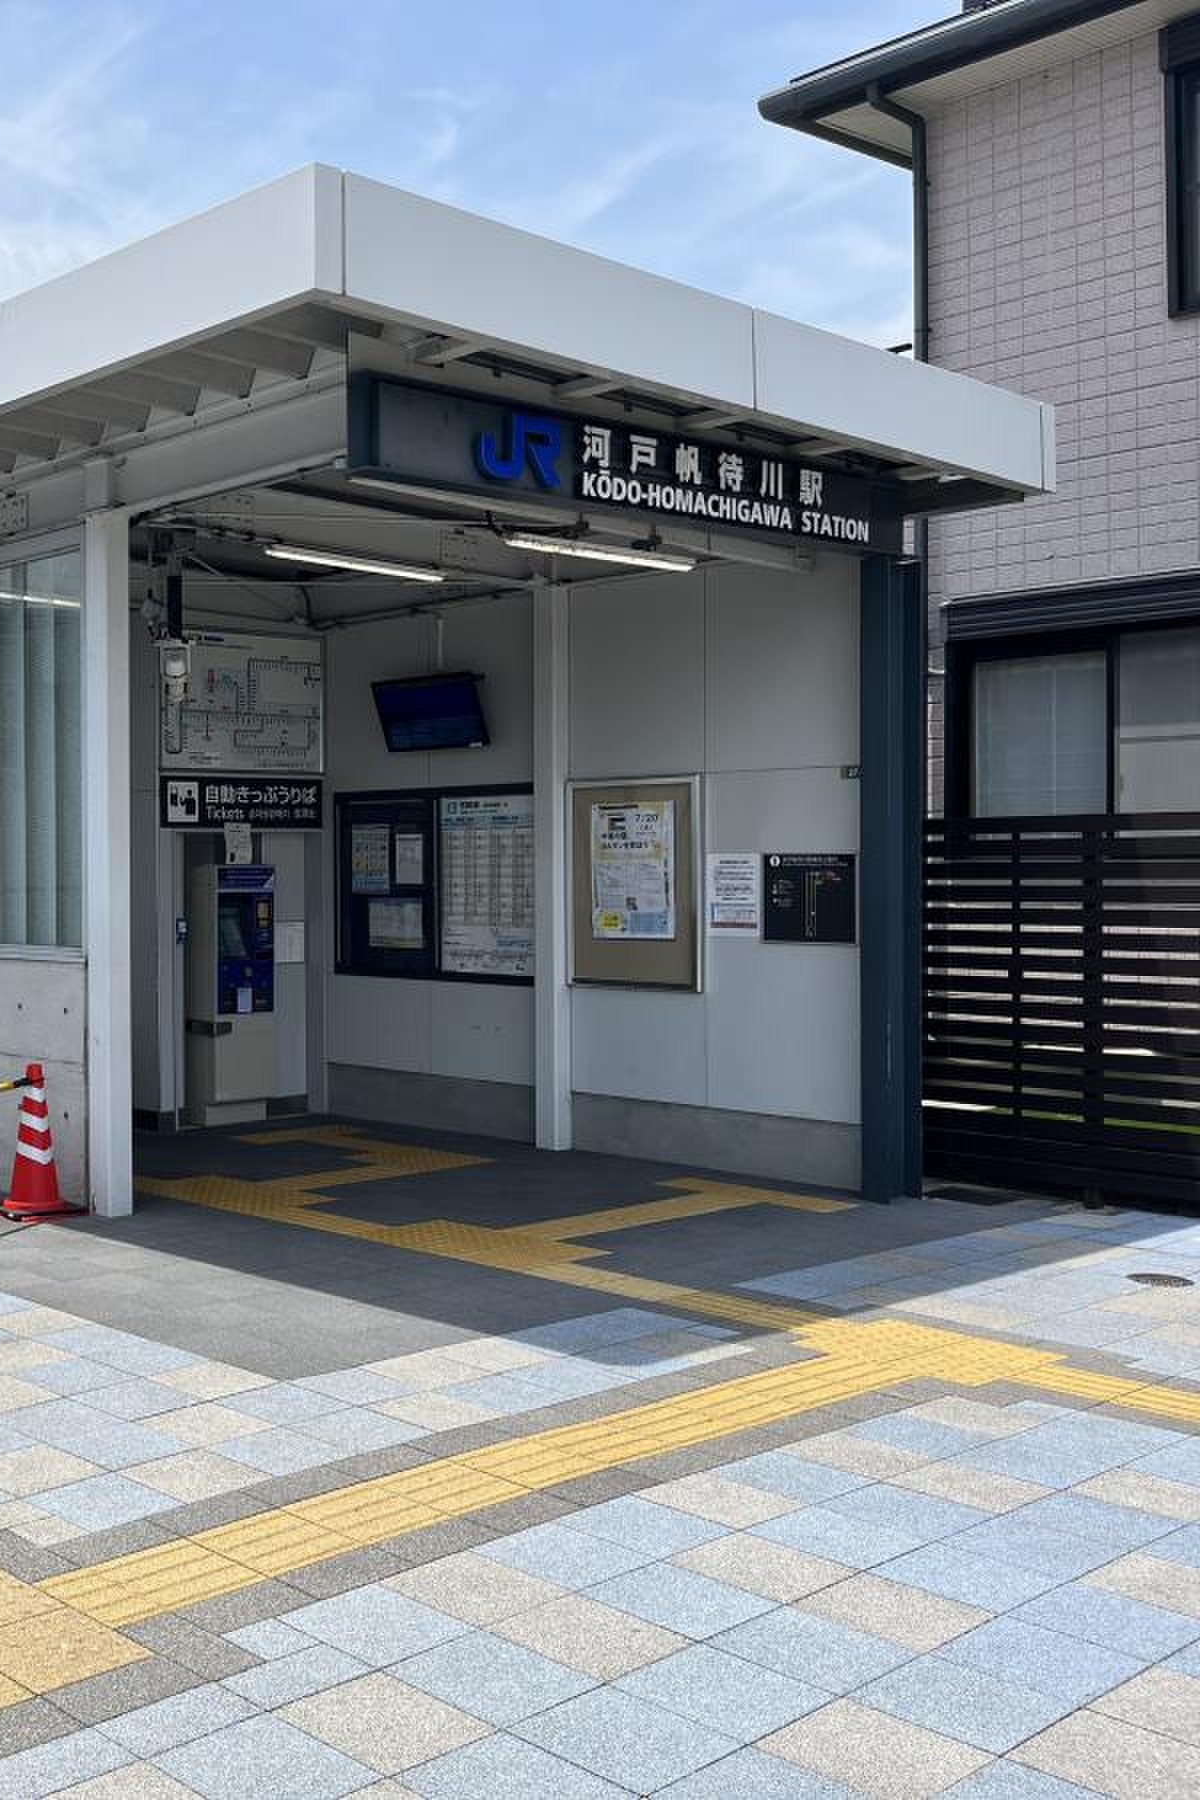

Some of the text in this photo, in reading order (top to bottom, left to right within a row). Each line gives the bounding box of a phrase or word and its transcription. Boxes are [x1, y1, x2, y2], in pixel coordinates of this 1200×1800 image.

[477, 414, 562, 488] JR
[582, 425, 824, 506] 河戸帆待川駅
[582, 469, 869, 543] KŌDO-HOMACHIGAWA STATION
[205, 784, 317, 805] 自動きっぷうりば
